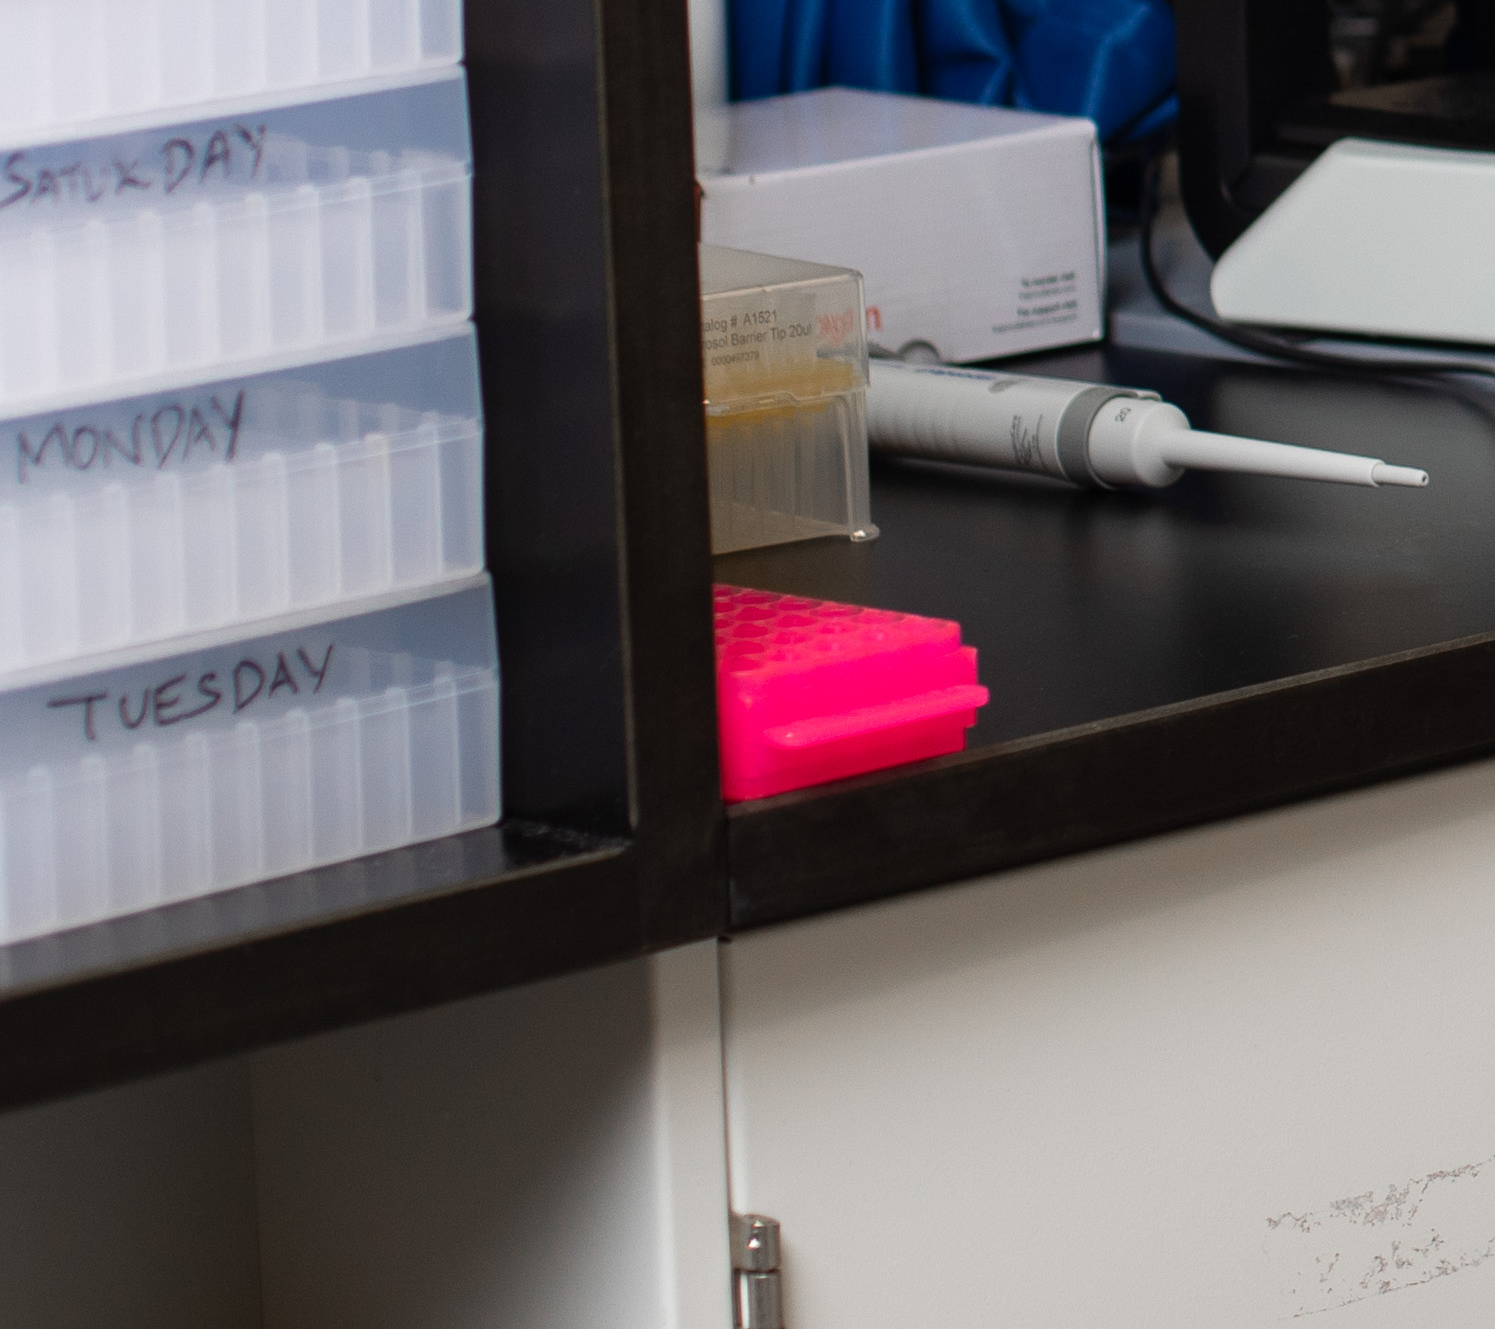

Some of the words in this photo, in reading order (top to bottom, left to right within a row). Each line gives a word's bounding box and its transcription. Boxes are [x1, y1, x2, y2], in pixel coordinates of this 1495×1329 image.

[703, 316, 728, 332] alog
[703, 336, 728, 350] osol
[16, 390, 246, 482] MONDAY
[47, 645, 334, 742] TUESDAY
